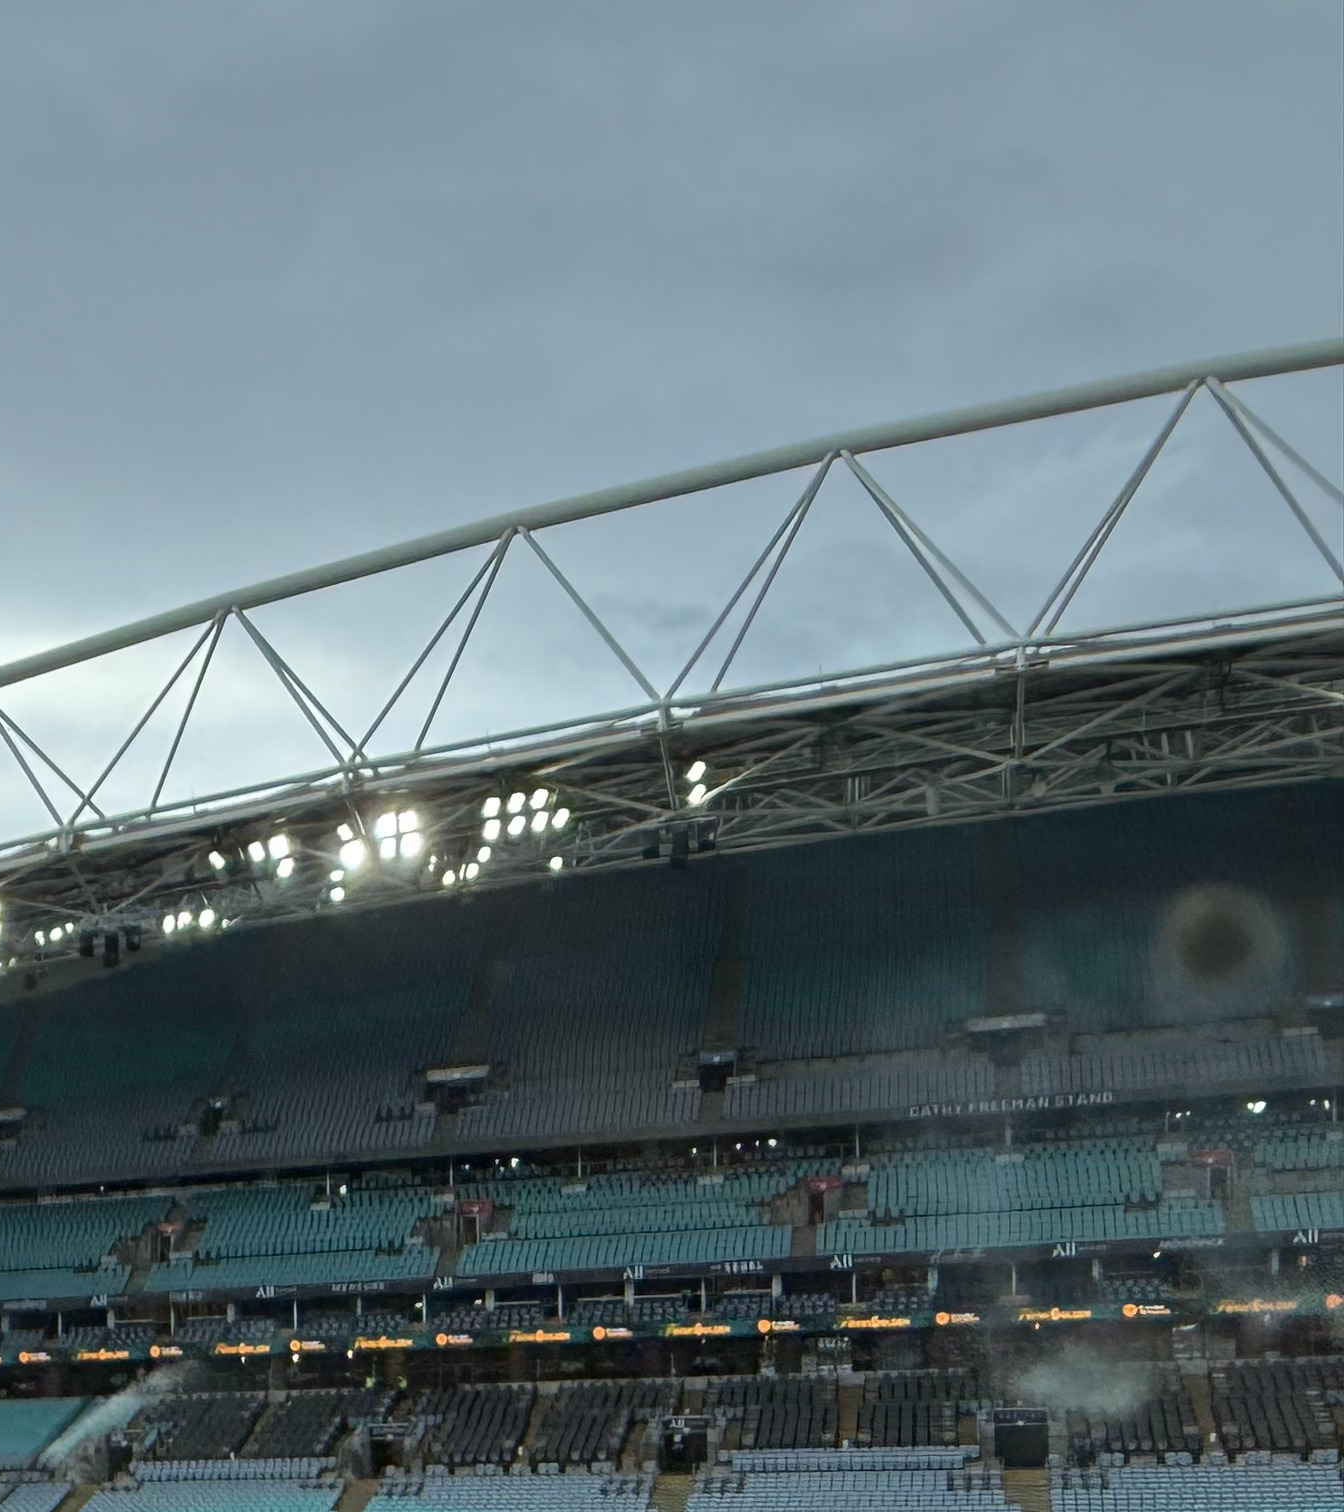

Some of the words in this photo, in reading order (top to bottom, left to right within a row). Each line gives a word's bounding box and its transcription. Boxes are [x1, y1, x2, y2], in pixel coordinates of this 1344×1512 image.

[909, 1104, 962, 1118] CATHY
[968, 1096, 1050, 1114] FREEMAN
[1054, 1091, 1114, 1107] STAND
